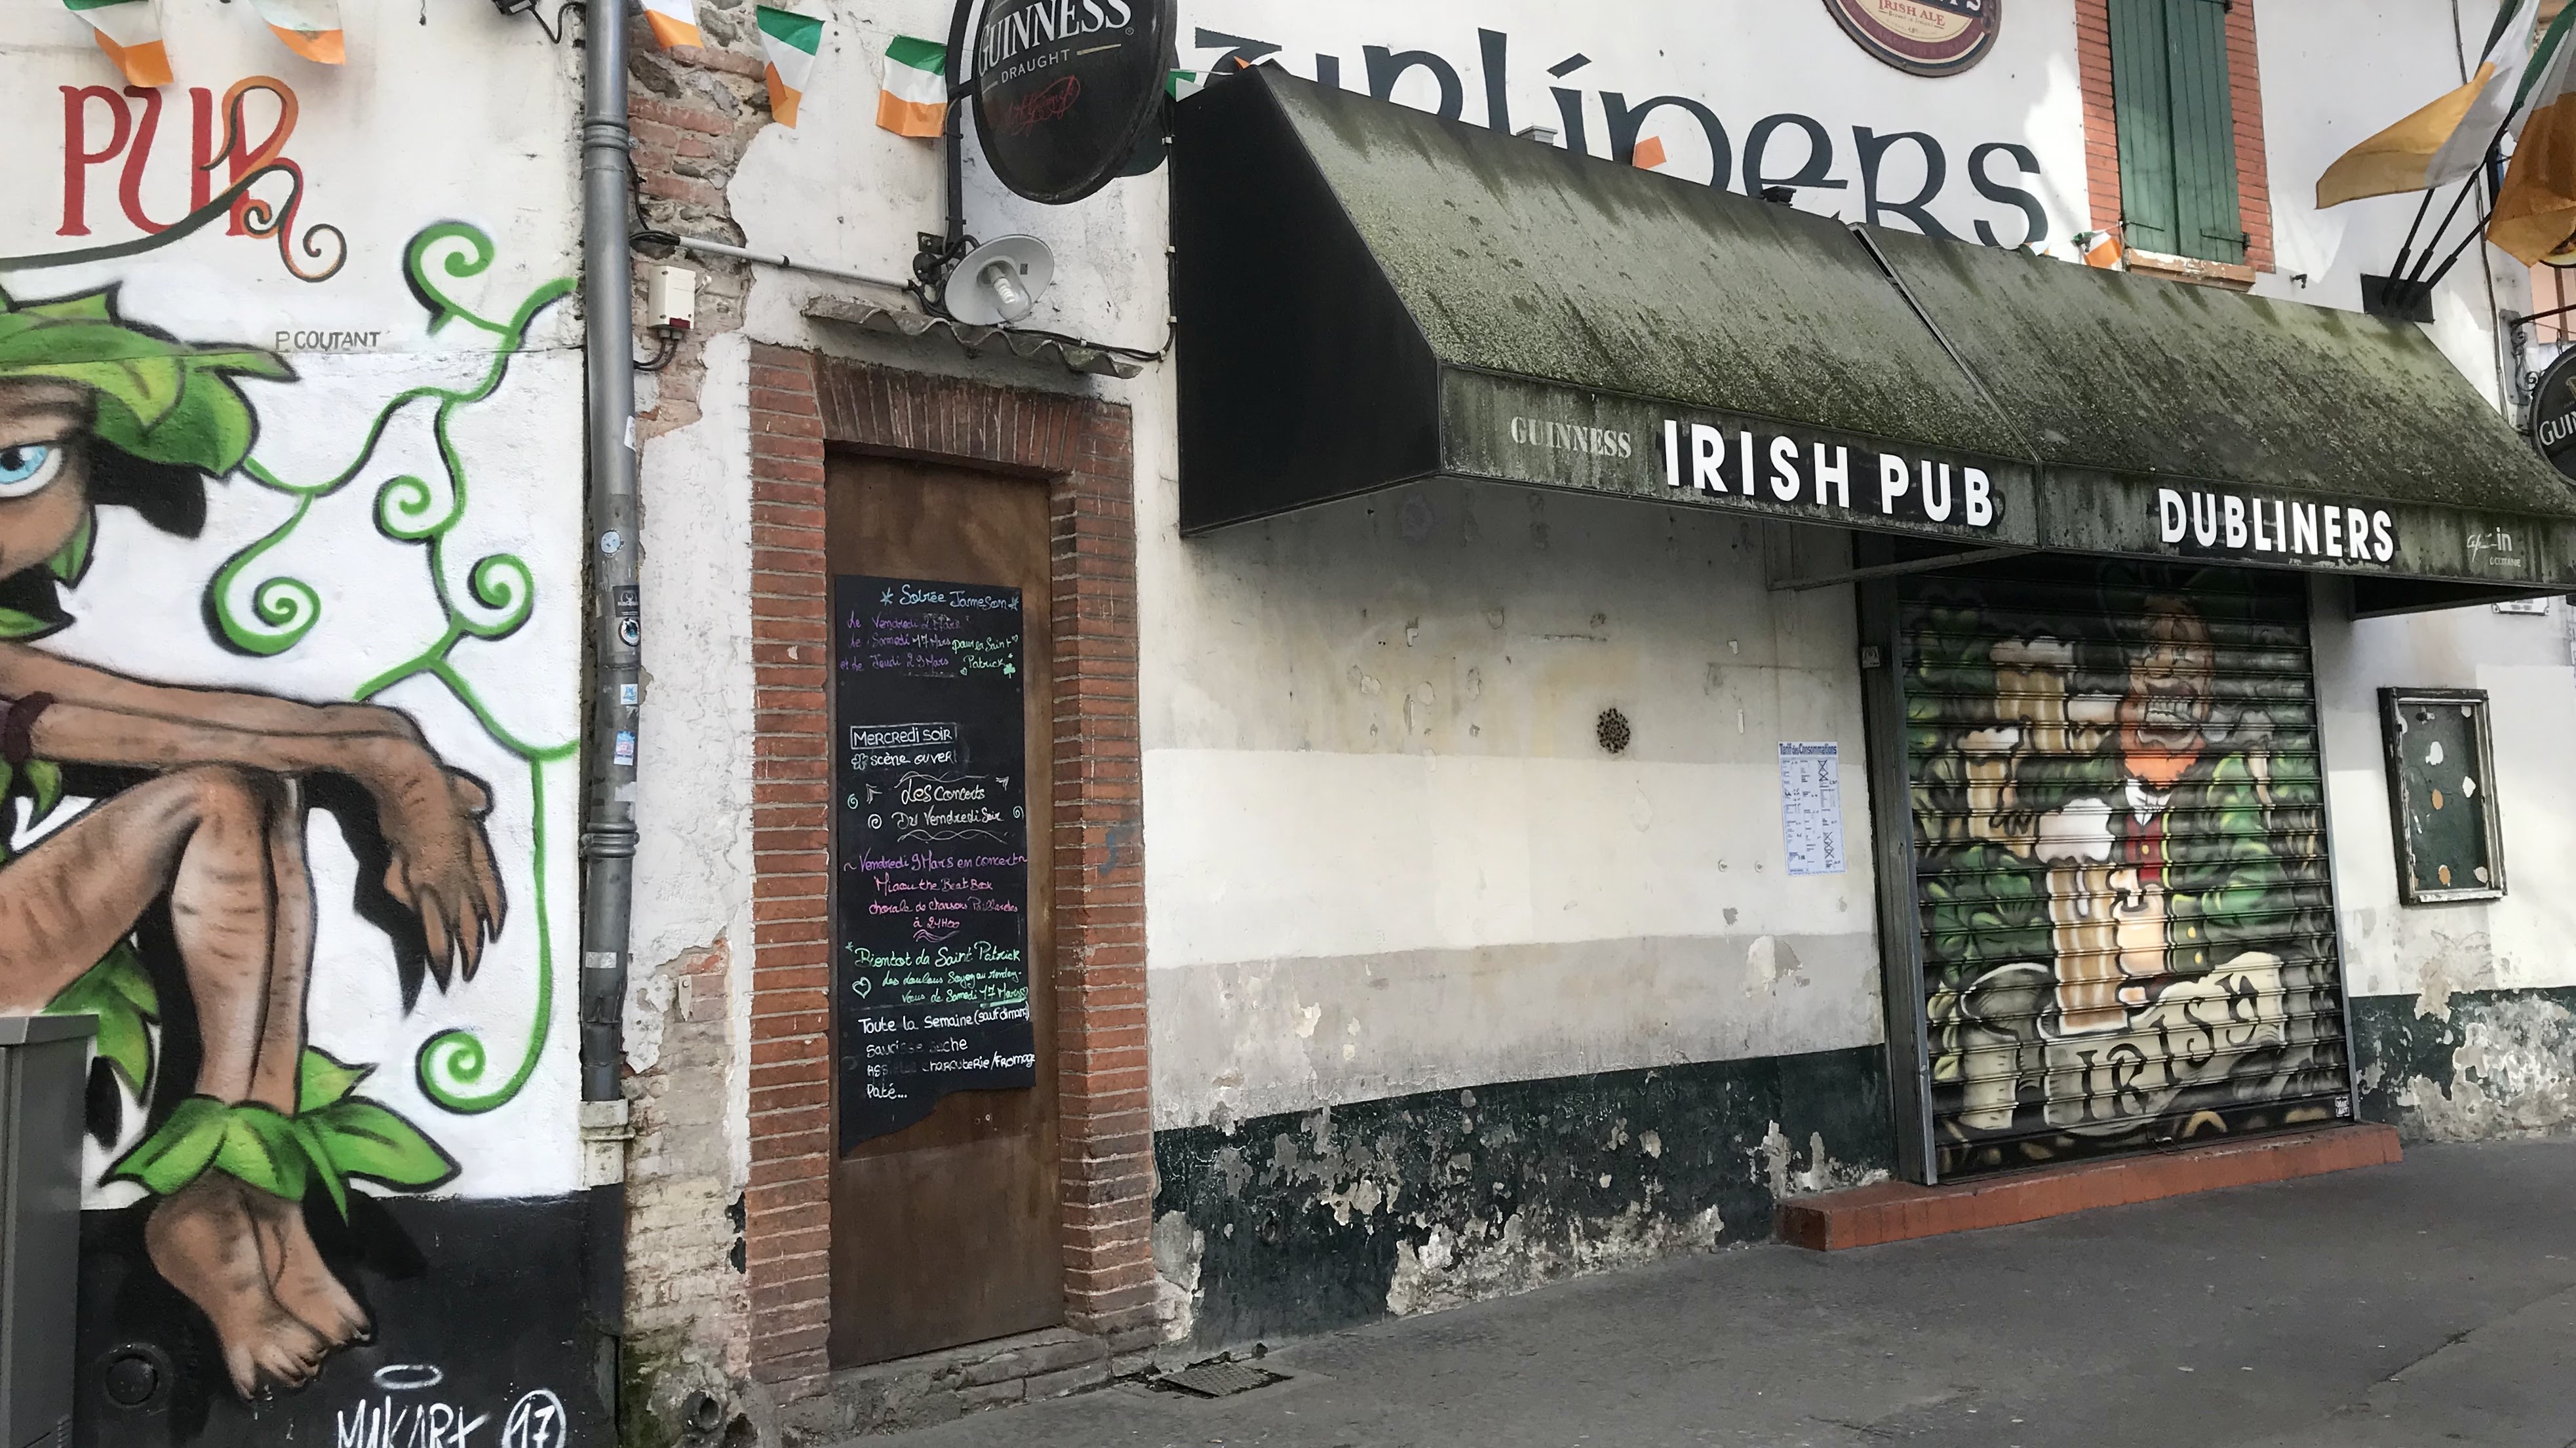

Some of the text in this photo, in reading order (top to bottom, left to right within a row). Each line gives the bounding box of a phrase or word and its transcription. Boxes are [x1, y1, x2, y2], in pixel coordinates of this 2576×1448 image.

[1879, 0, 1916, 16] IRISH
[1920, 10, 1945, 26] ALE
[979, 0, 1131, 77] GUINNESS
[1001, 49, 1071, 84] DRAUGHT
[294, 330, 381, 351] COUTANT
[1510, 416, 1632, 460] GUINNESS
[1663, 419, 1993, 528] IRISH PUB
[2158, 488, 2394, 562] DUBLINERS
[899, 584, 946, 606] Soirée
[872, 611, 918, 631] Vendredi
[872, 632, 910, 648] Samedi
[912, 633, 929, 648] 17
[929, 633, 952, 650] Mars
[952, 639, 974, 654] pour
[985, 636, 1012, 652] Saint
[870, 654, 902, 670] Jeudi
[925, 654, 950, 670] Mars
[963, 654, 1006, 669] Patrick
[870, 752, 912, 766] scène
[1799, 742, 1837, 756] Consommations
[934, 784, 986, 802] Concerts
[891, 805, 1004, 830] Du Vendredi Soir
[859, 847, 909, 872] Vendredi
[910, 853, 921, 871] 9
[922, 850, 954, 872] Mars
[957, 858, 972, 869] en
[919, 878, 940, 891] the
[941, 877, 969, 892] Beat
[971, 880, 993, 891] Box
[916, 899, 926, 912] de
[855, 947, 913, 968] Bientot
[935, 946, 973, 968] Saint
[973, 941, 1021, 962] Patrick
[946, 988, 977, 1002] Samedi
[980, 984, 996, 1000] 17
[996, 982, 1021, 1000] Mars
[858, 1016, 897, 1034] Toute
[903, 1015, 919, 1030] la
[2077, 973, 2259, 1122] IRISH
